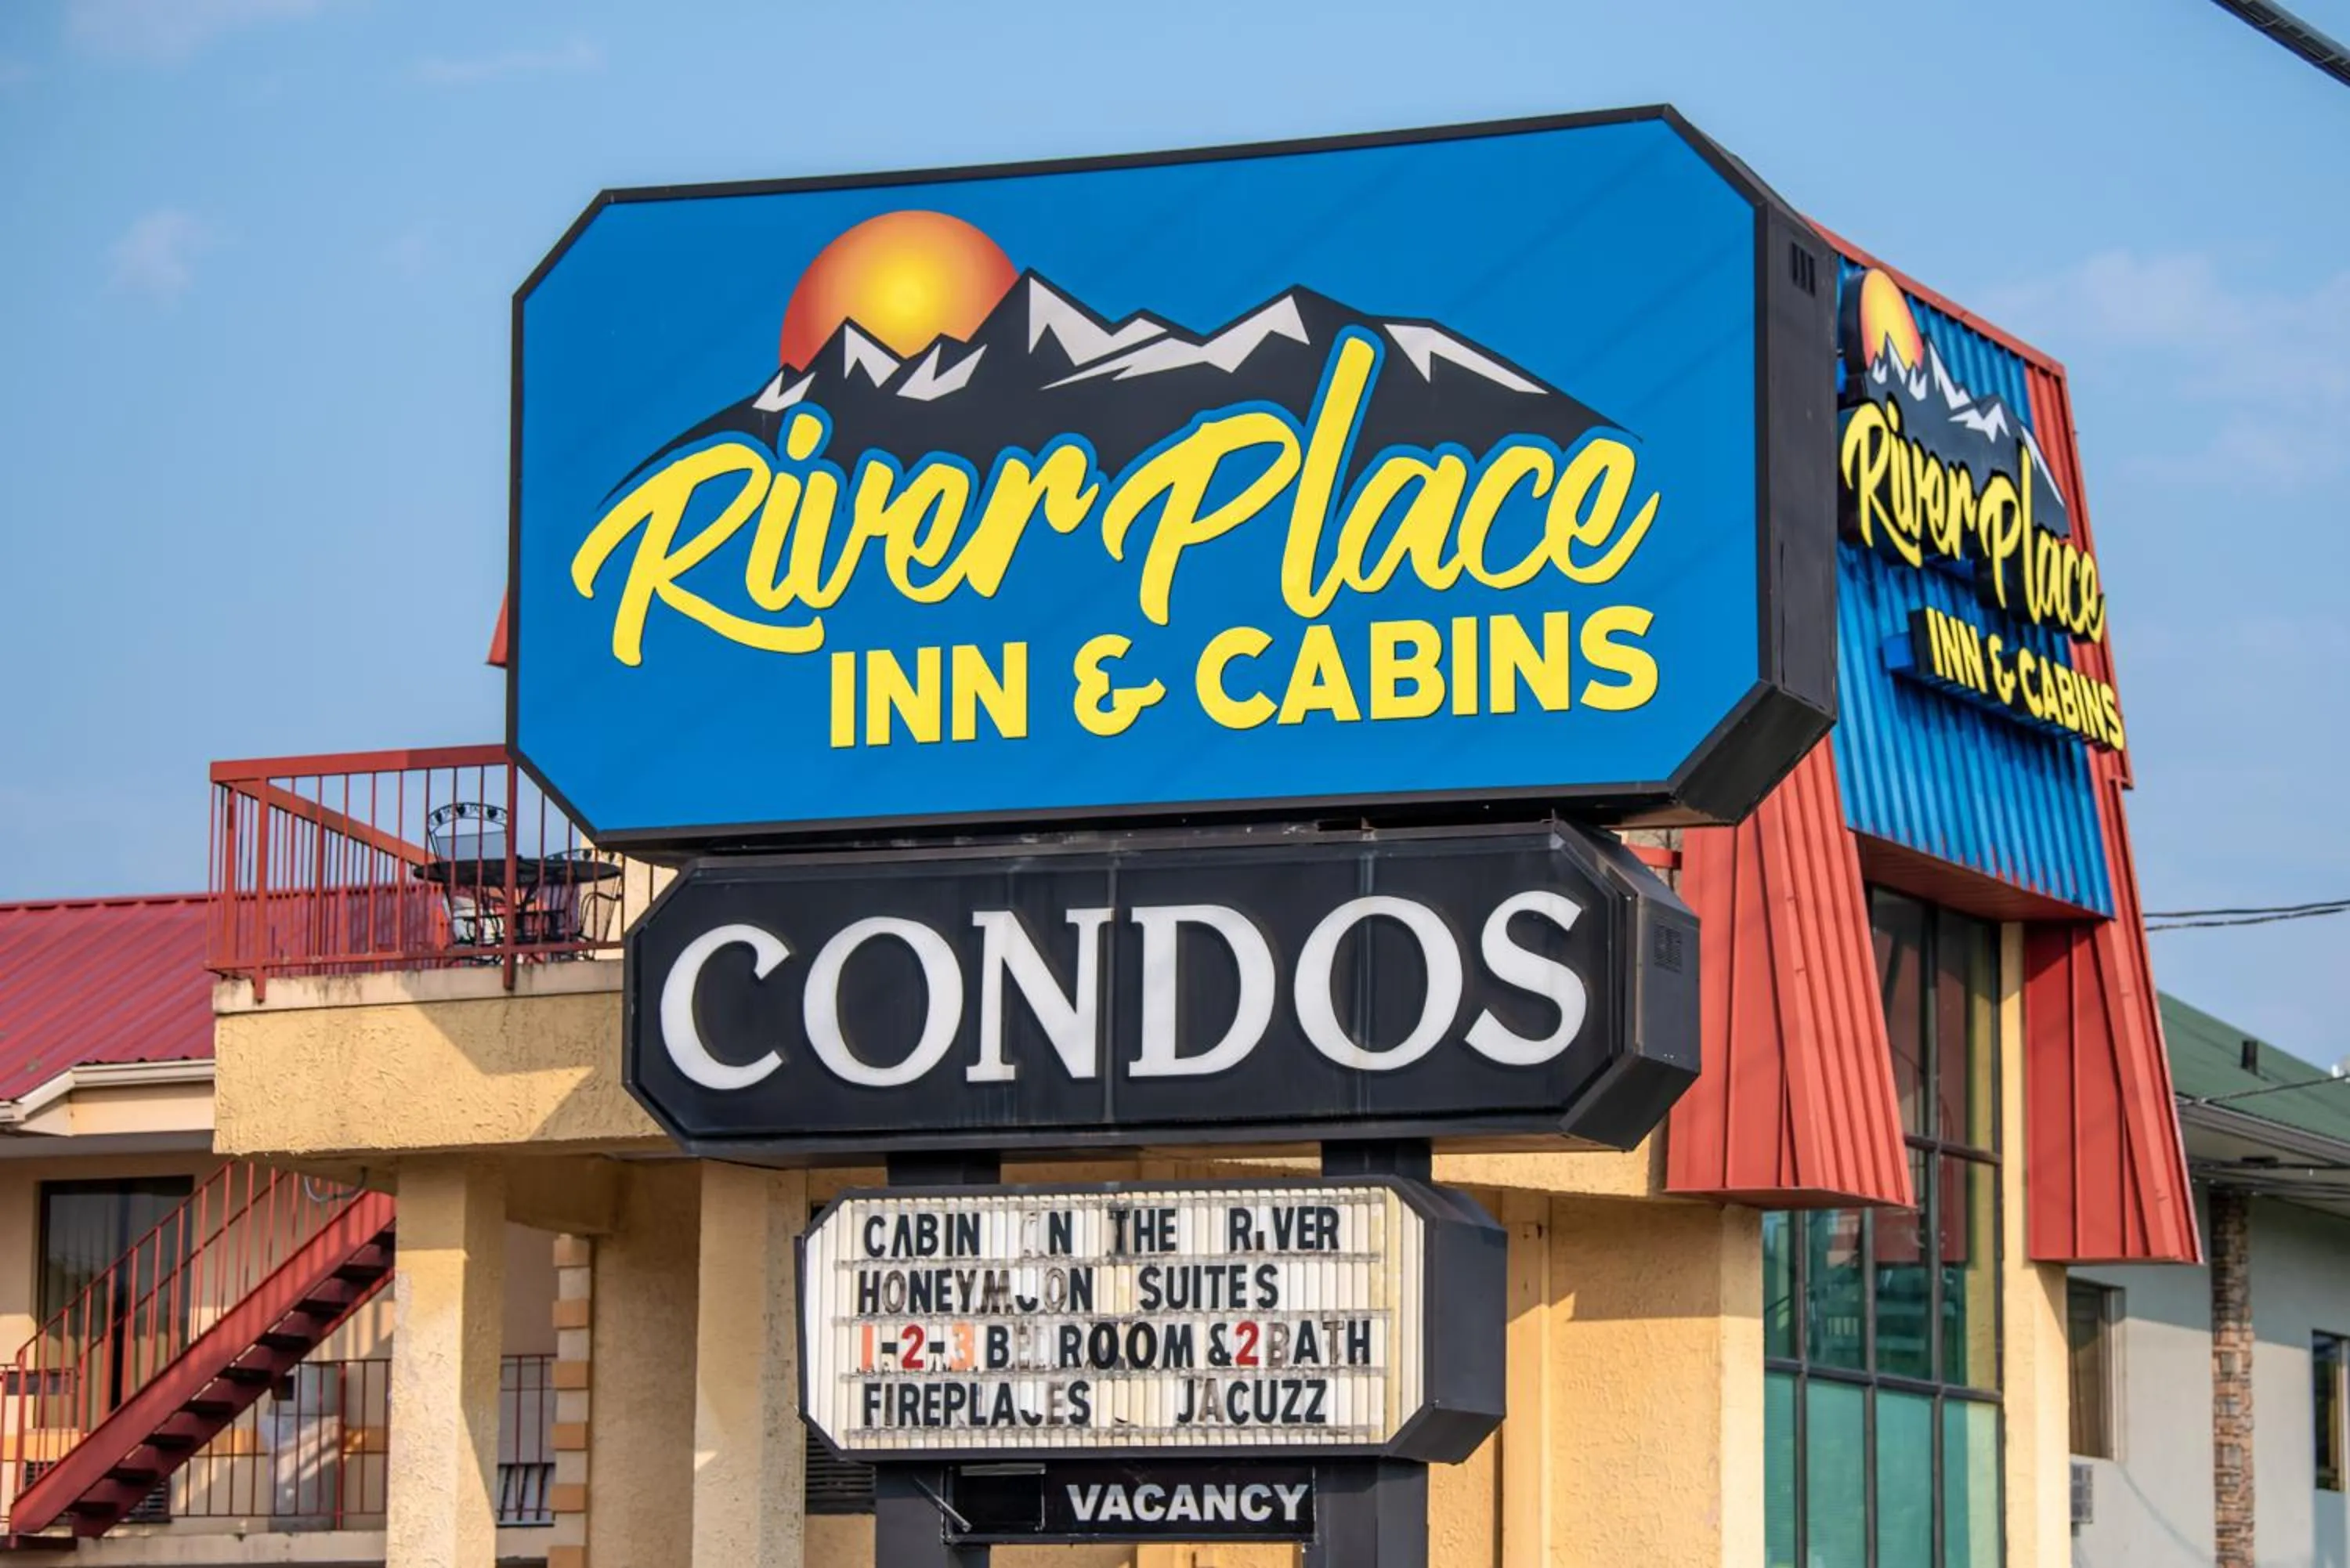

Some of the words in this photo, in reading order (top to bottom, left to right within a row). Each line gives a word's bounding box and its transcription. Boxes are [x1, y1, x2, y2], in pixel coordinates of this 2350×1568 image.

[571, 412, 1099, 667] River
[1103, 336, 1660, 626] Place
[1842, 399, 1977, 567] River
[1979, 444, 2106, 643] Place
[830, 641, 1029, 748] INN
[1073, 634, 1166, 736] &
[1195, 604, 1659, 730] CABINS
[1926, 605, 1987, 693] INN
[1987, 634, 2016, 704] &
[2018, 647, 2124, 750] CABINS
[660, 890, 1588, 1090] CONDOS
[863, 1212, 980, 1257] CABIN
[1108, 1209, 1177, 1253] THE
[1139, 1263, 1279, 1310] SUITES
[986, 1321, 1195, 1370] BROOM
[1177, 1378, 1327, 1425] JACUZZ
[1065, 1483, 1307, 1523] VACANCY
